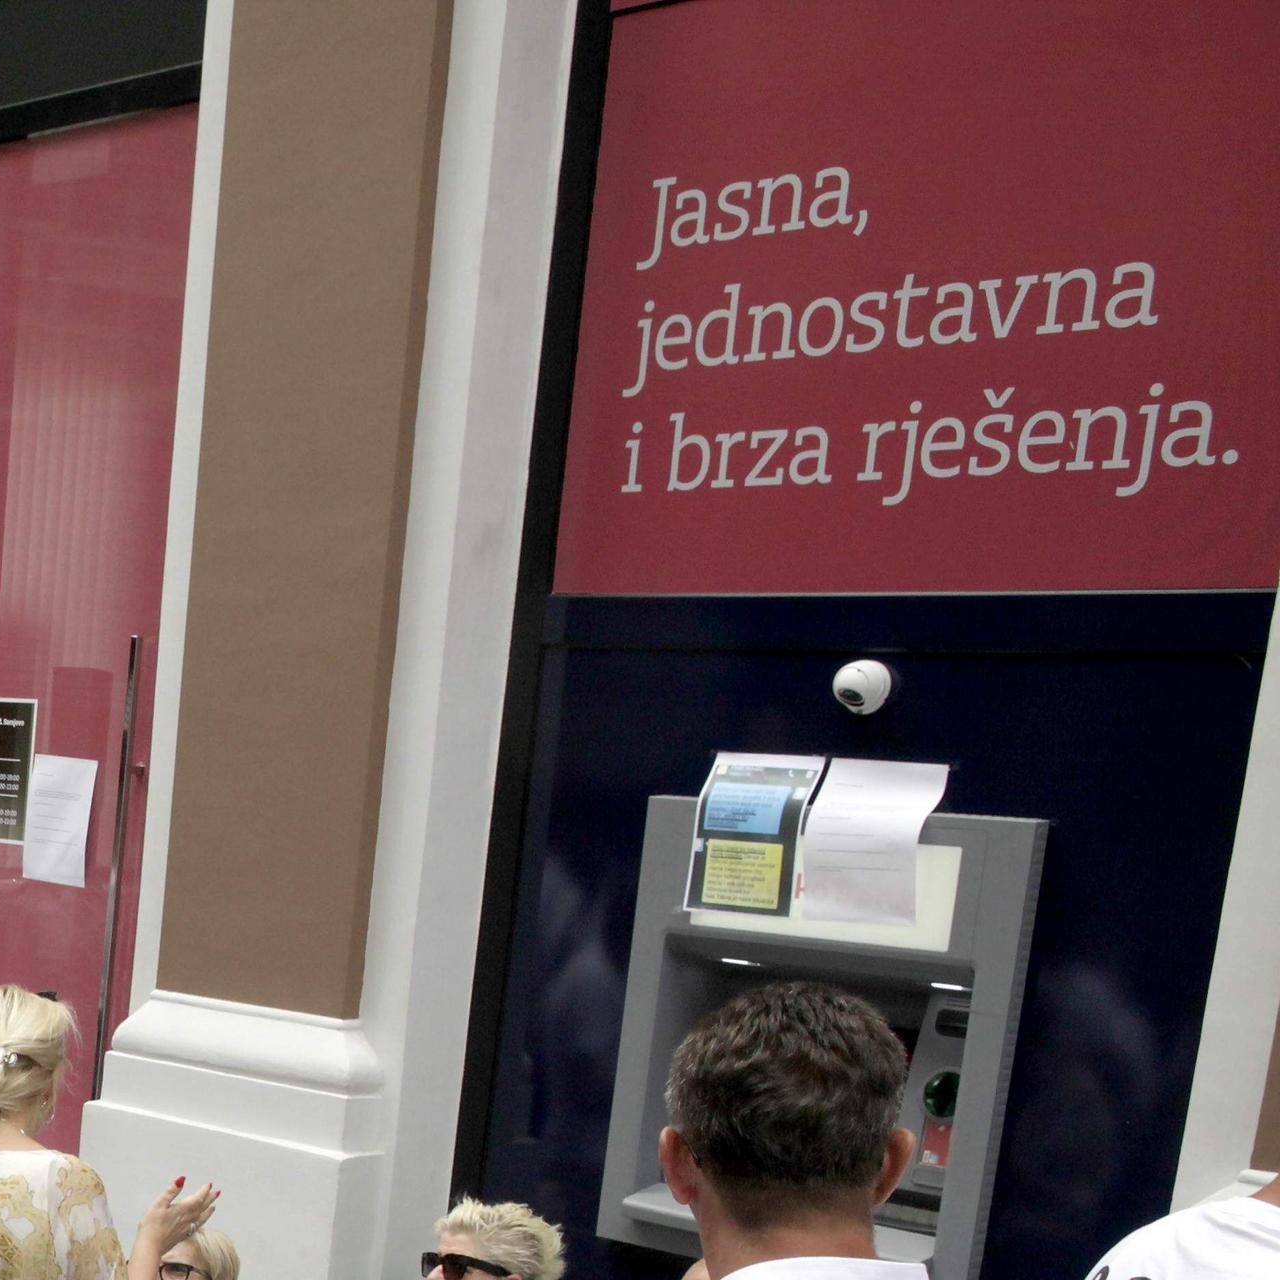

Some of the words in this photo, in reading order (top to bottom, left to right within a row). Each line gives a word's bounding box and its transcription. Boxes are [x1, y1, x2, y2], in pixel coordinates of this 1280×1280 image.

[636, 165, 870, 271] Jasna,
[622, 260, 1160, 399] jednostavna
[621, 421, 644, 494] i
[667, 411, 833, 494] brza
[856, 382, 1240, 506] rješenja.
